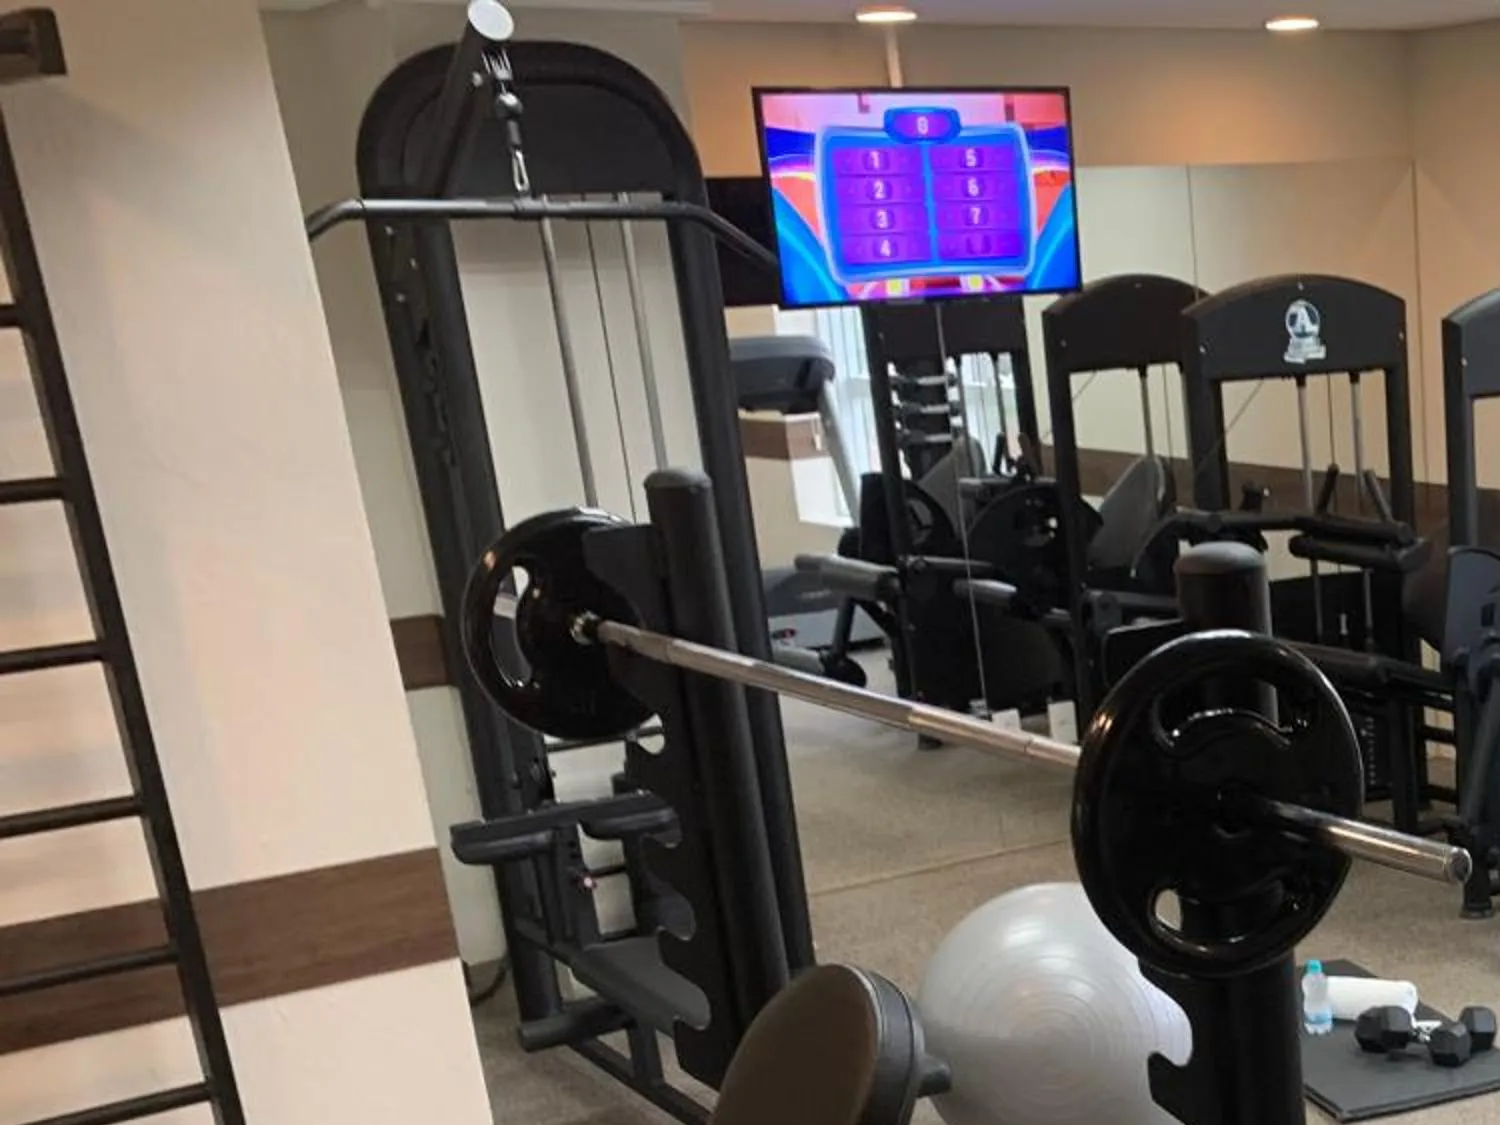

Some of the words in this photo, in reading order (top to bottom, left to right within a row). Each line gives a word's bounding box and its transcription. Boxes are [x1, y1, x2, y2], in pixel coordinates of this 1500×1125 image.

[870, 150, 880, 169] 1
[965, 148, 977, 168] 5
[874, 180, 886, 199] 2
[968, 177, 980, 197] 6
[876, 209, 889, 229] 3
[970, 207, 982, 225] 7
[880, 239, 892, 257] 4
